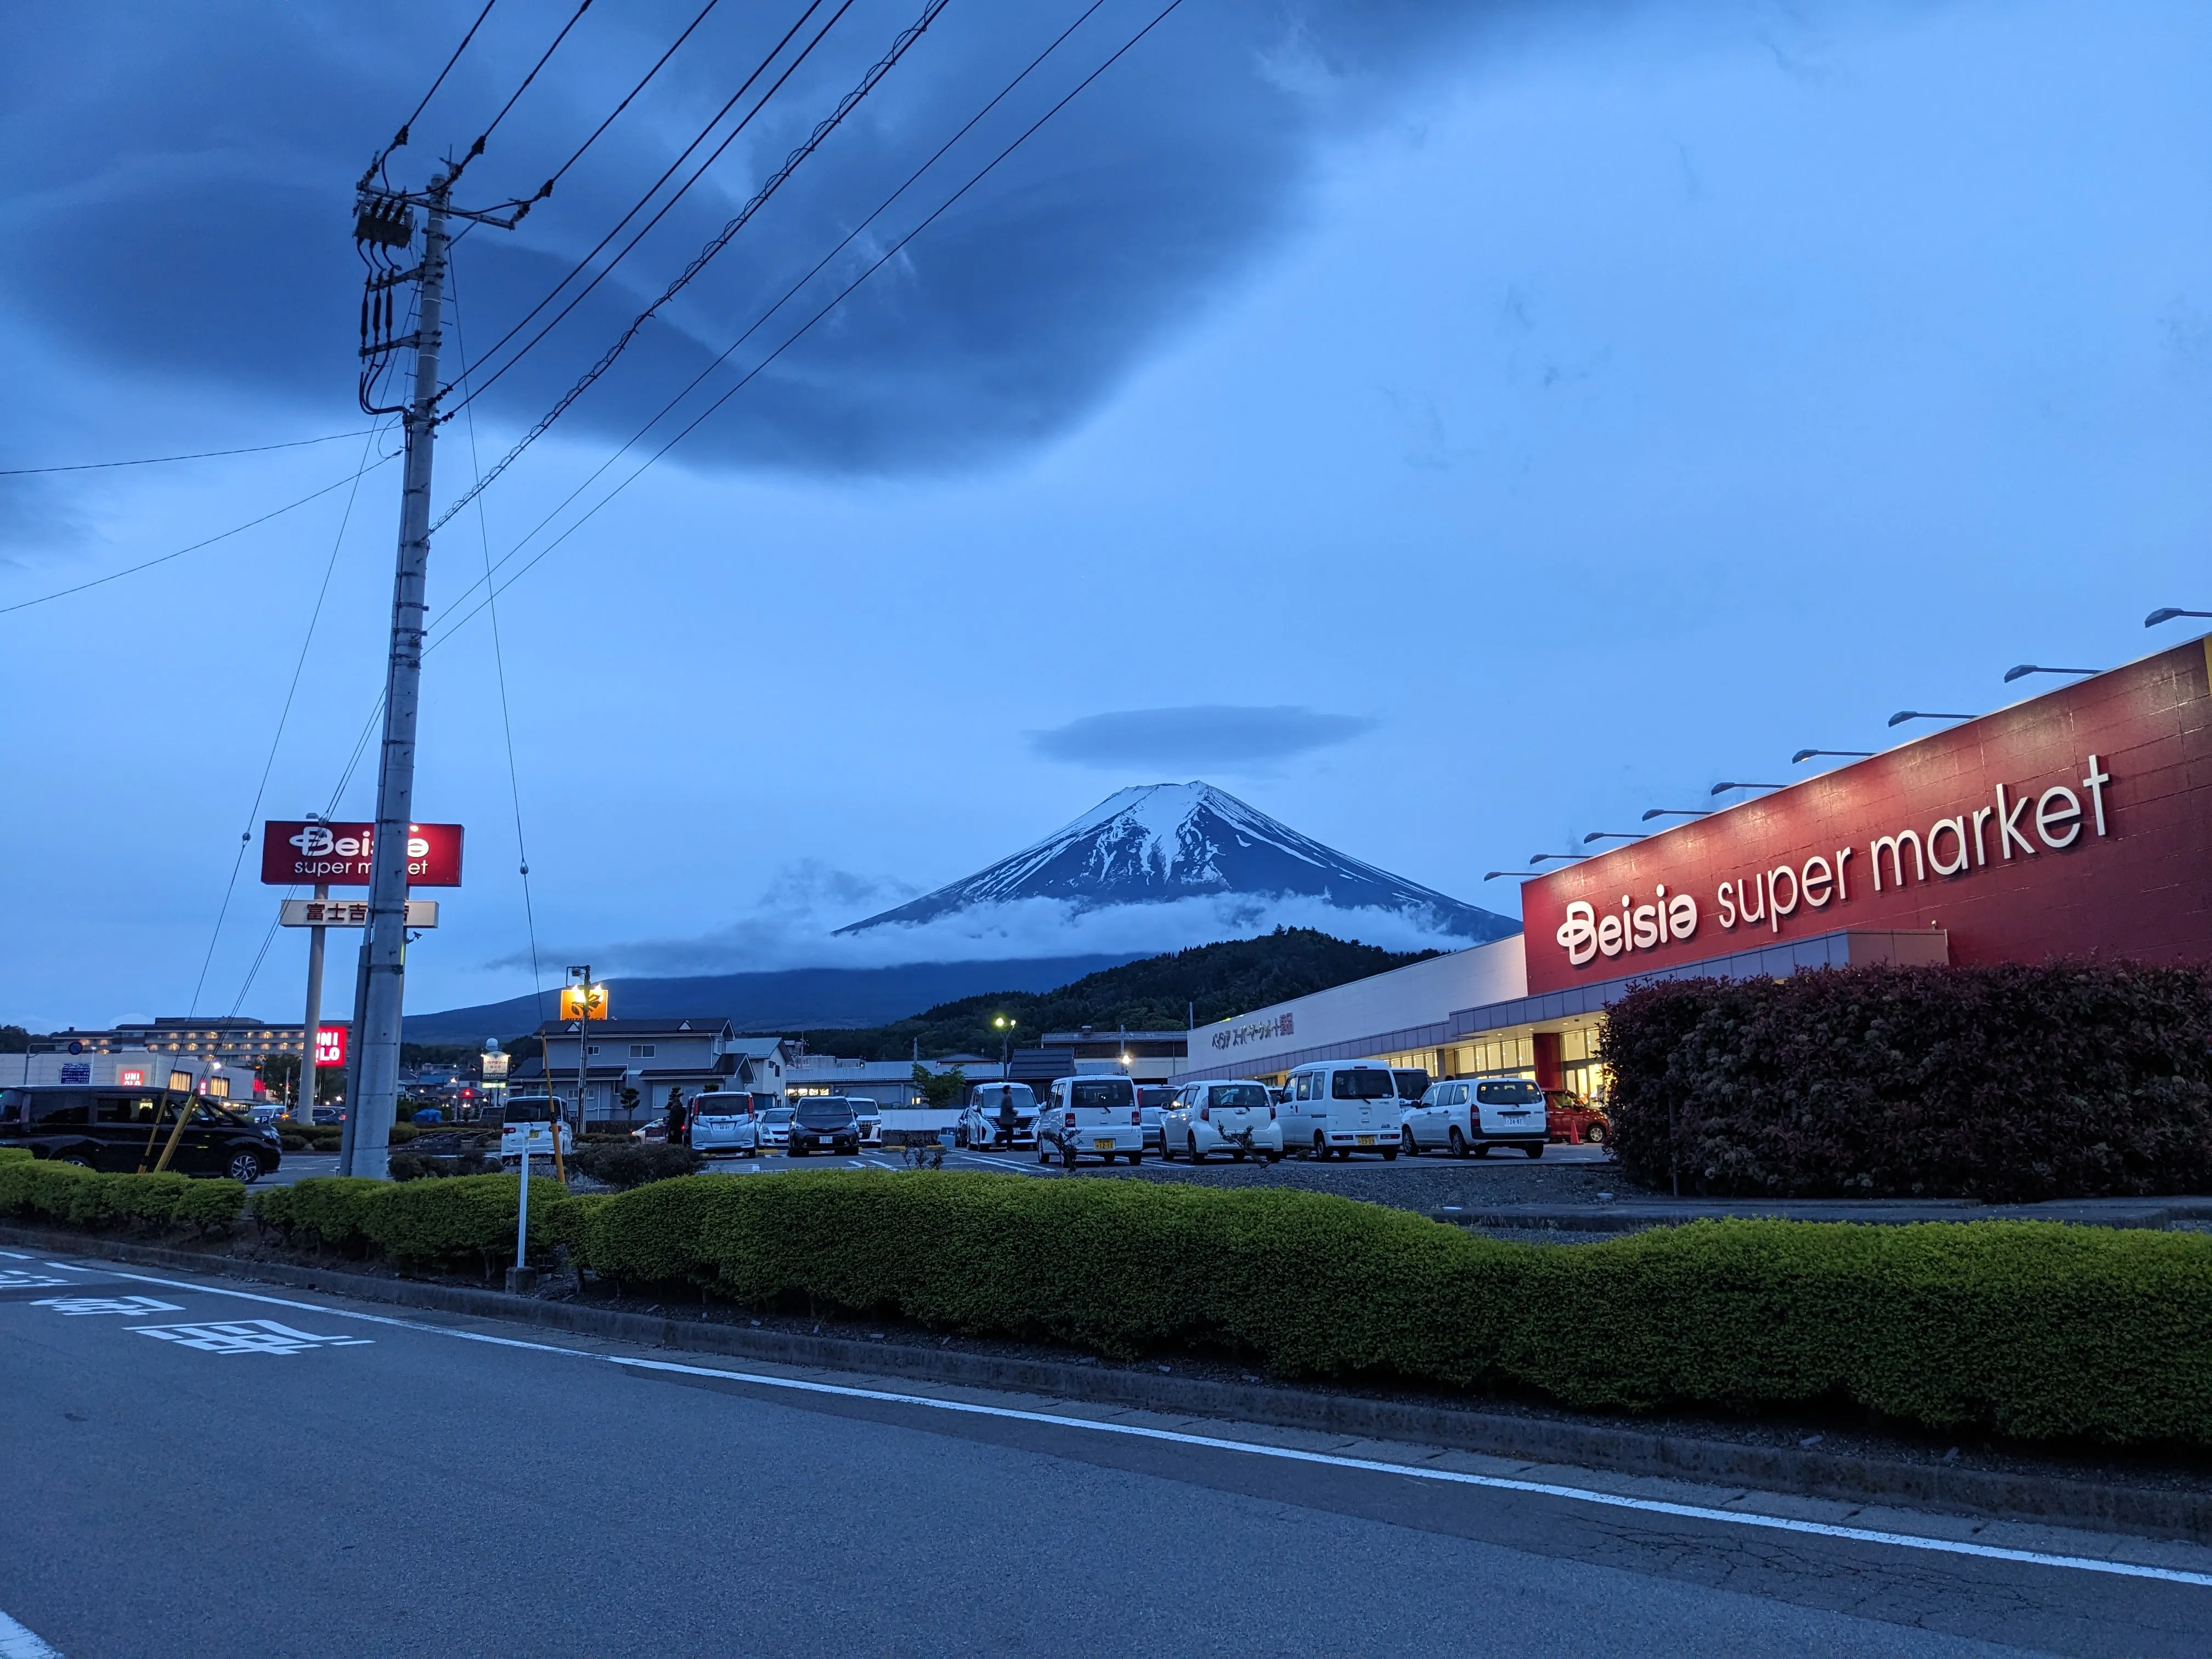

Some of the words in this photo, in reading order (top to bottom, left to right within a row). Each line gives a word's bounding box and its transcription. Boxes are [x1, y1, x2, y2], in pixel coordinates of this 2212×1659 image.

[290, 827, 429, 857] Beia
[295, 861, 352, 877] super
[358, 860, 428, 874] met
[1557, 883, 1697, 965] Beisia
[1718, 846, 1854, 933] super
[1870, 754, 2109, 891] market
[307, 902, 409, 921] 富士吉
[315, 1047, 340, 1063] LO
